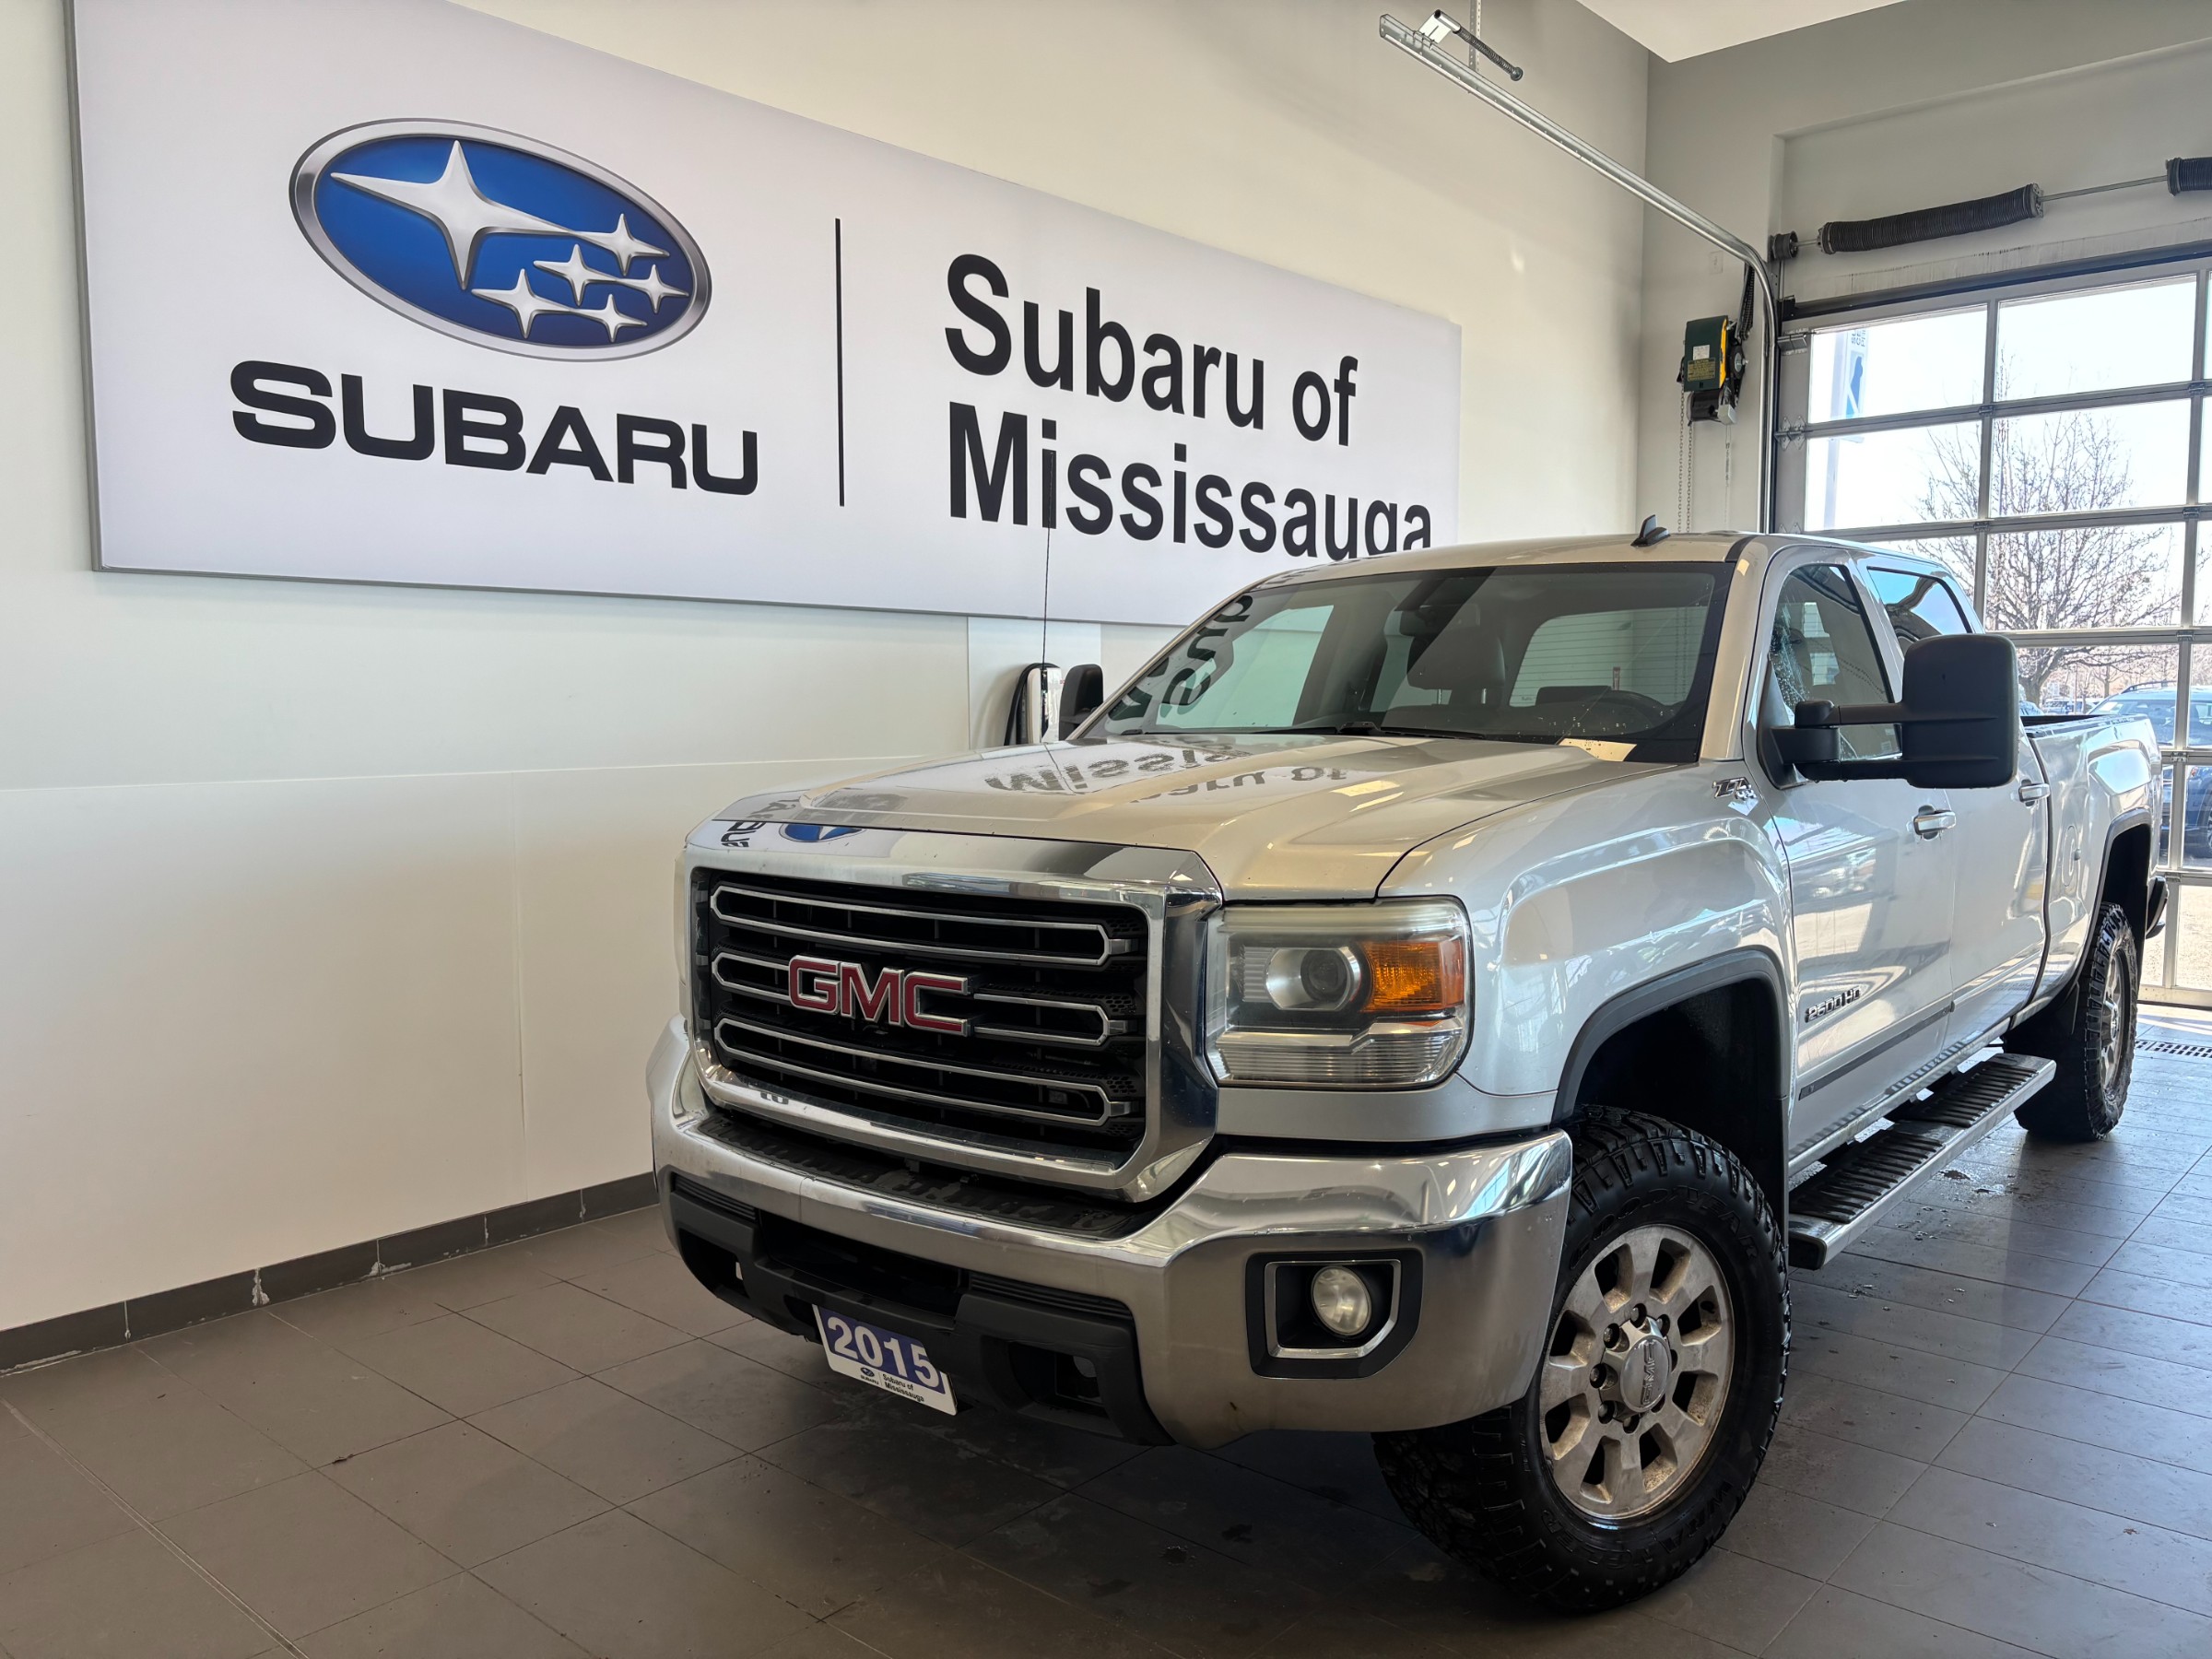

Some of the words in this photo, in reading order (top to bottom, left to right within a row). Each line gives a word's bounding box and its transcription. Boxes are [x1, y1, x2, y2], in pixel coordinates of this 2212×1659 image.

[945, 253, 1264, 430] Subaru
[1291, 355, 1359, 447] of
[230, 360, 759, 496] SUBARU
[949, 401, 1431, 561] Mississauga
[789, 955, 969, 1038] GMC
[828, 1317, 940, 1388] 2015
[883, 1374, 906, 1388] Subaru
[1641, 1341, 1655, 1406] GMC
[884, 1382, 924, 1402] Mississauga
